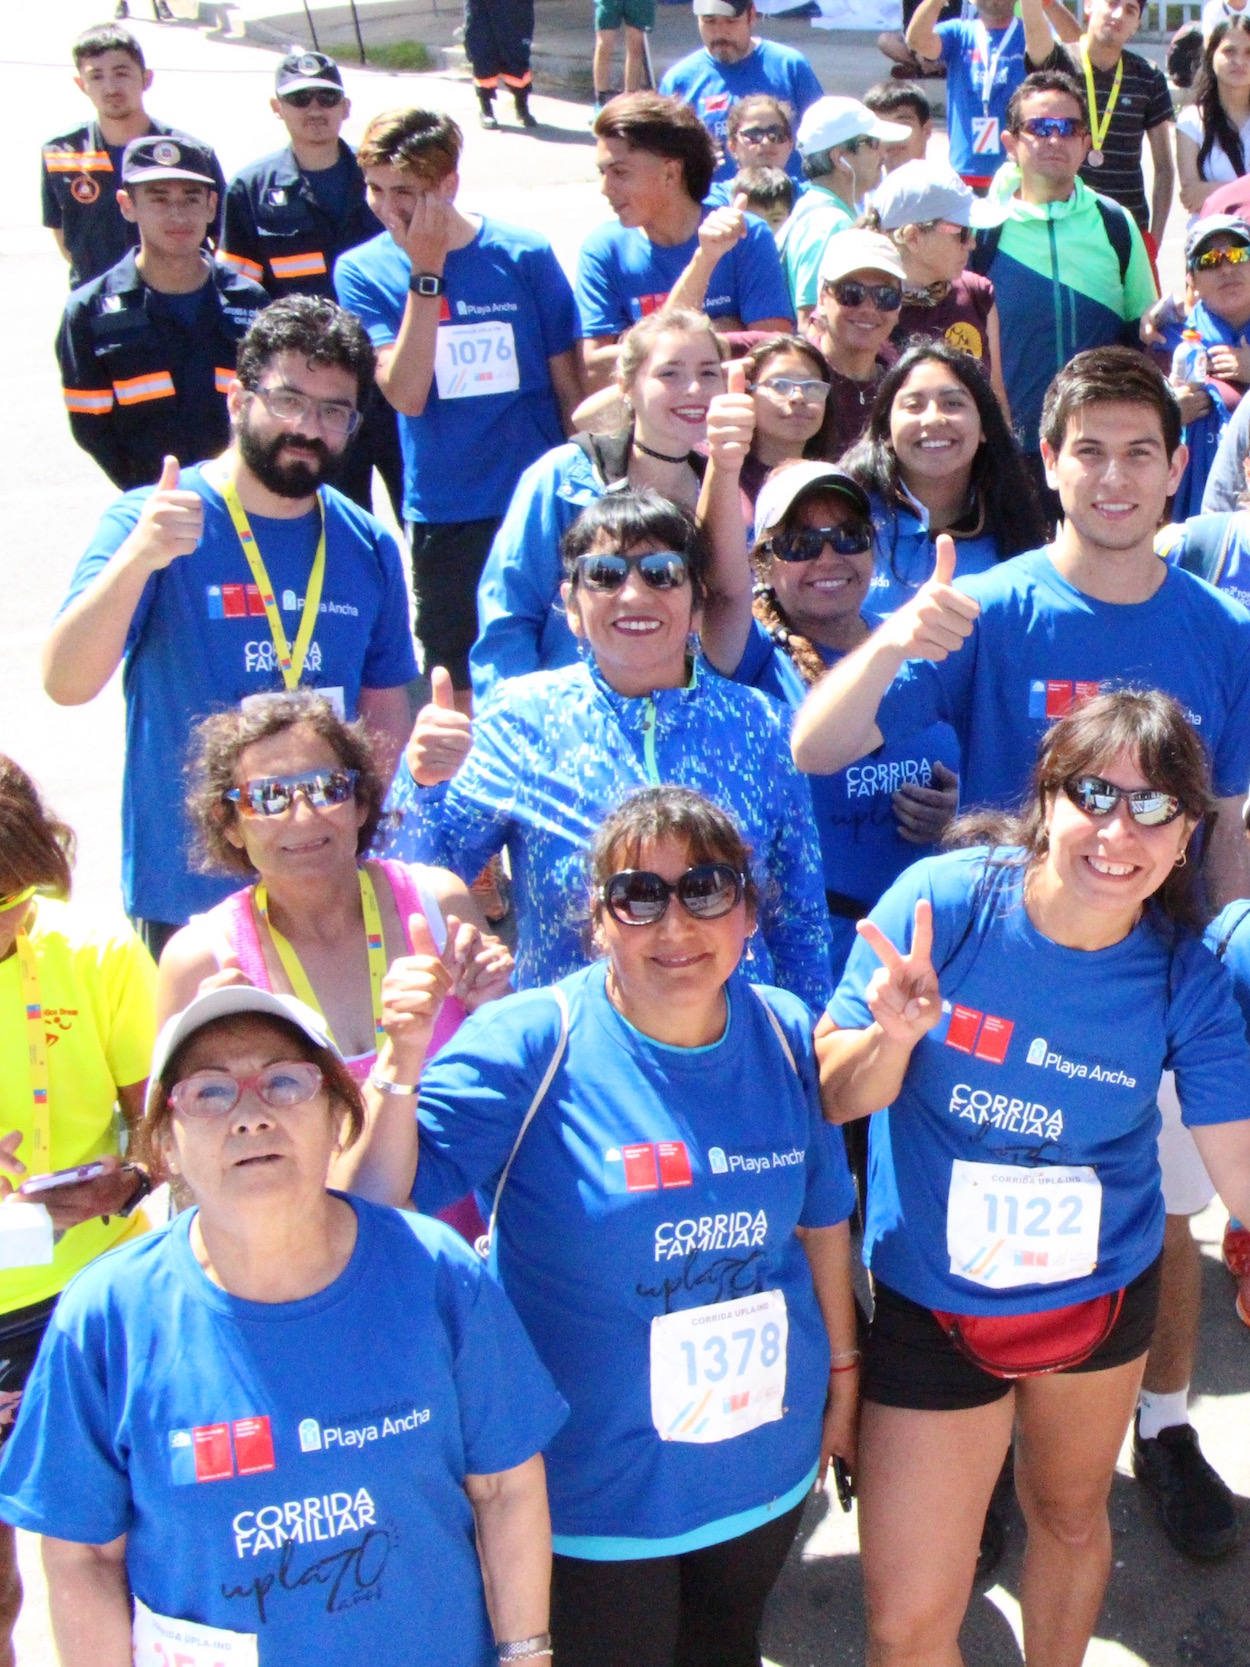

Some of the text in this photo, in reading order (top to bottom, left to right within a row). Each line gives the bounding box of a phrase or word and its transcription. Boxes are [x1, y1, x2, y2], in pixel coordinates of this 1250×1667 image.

[448, 337, 511, 366] 1076
[328, 601, 358, 616] Ancha
[846, 758, 932, 784] CORRIDA
[1044, 1052, 1088, 1079] Playa
[1089, 1065, 1136, 1088] Ancha
[949, 1098, 1063, 1142] FAMILIAR
[952, 1083, 1064, 1129] CORRIDA
[729, 1155, 770, 1174] Playa
[992, 1175, 1034, 1185] CORRIDA
[655, 1209, 768, 1245] CORRIDA
[983, 1193, 1083, 1237] 1122
[655, 1227, 766, 1262] FAMILIAR
[692, 1313, 732, 1326] CORRIDA
[681, 1321, 780, 1386] 1378
[323, 1409, 430, 1449] Playa Ancha
[232, 1487, 374, 1536] CORRIDA
[235, 1505, 377, 1558] FAMILIAR
